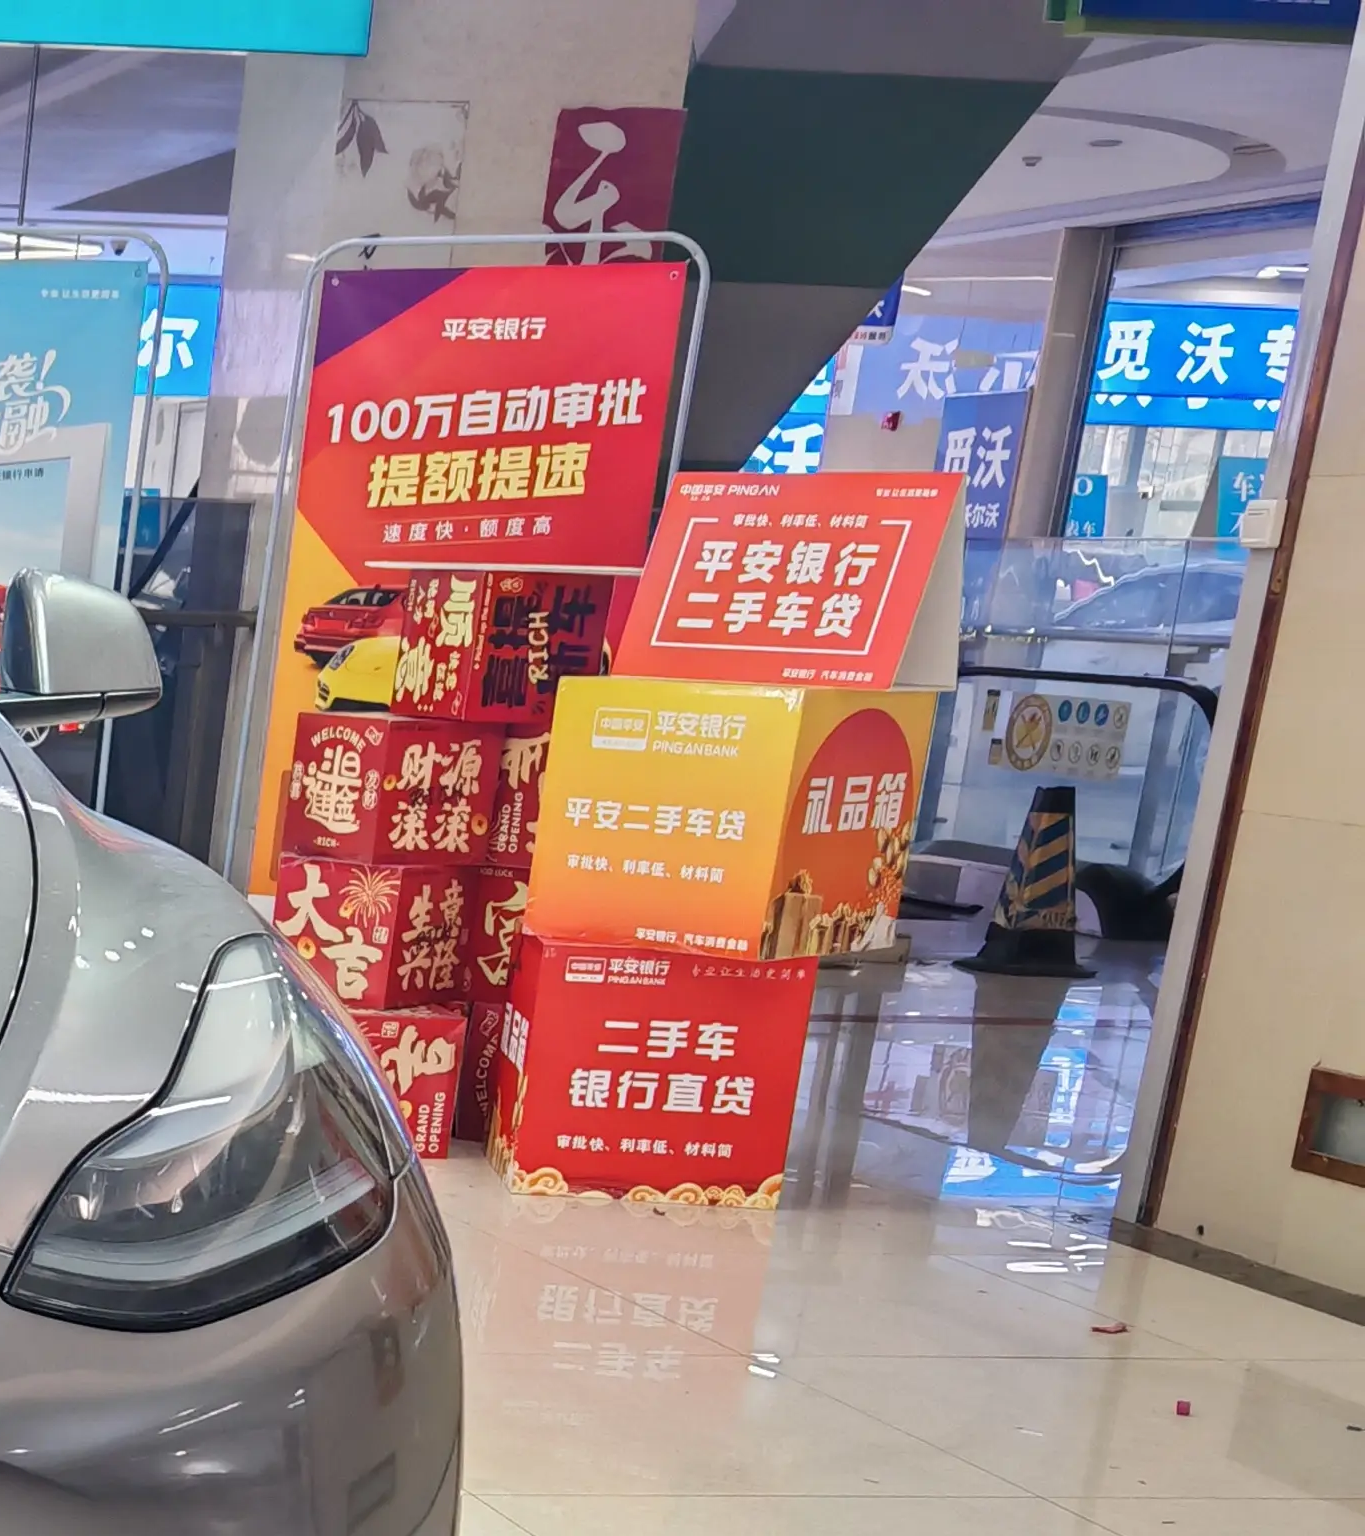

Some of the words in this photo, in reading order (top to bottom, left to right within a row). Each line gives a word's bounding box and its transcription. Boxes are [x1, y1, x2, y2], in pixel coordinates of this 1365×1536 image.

[442, 316, 547, 342] 平安银行
[327, 377, 647, 444] 100万自动审批
[366, 442, 592, 508] 提额提速
[727, 484, 780, 497] PINGAN
[695, 540, 881, 587] 平安银行
[677, 592, 863, 638] 二手车贷
[528, 611, 550, 685] RICH
[311, 726, 366, 753] WELCOME
[655, 711, 747, 741] 平安银行
[508, 791, 524, 854] OPENING
[565, 797, 746, 841] 平安二手车贷
[802, 772, 908, 835] 礼品箱
[497, 803, 511, 852] GRAND
[274, 863, 384, 1000] 大吉
[608, 957, 670, 975] 平安银行
[598, 1020, 739, 1062] 二手车
[569, 1068, 755, 1116] 银行直贷
[428, 1091, 447, 1153] OPENING
[557, 1134, 733, 1159] 审批快、利率低、材料简
